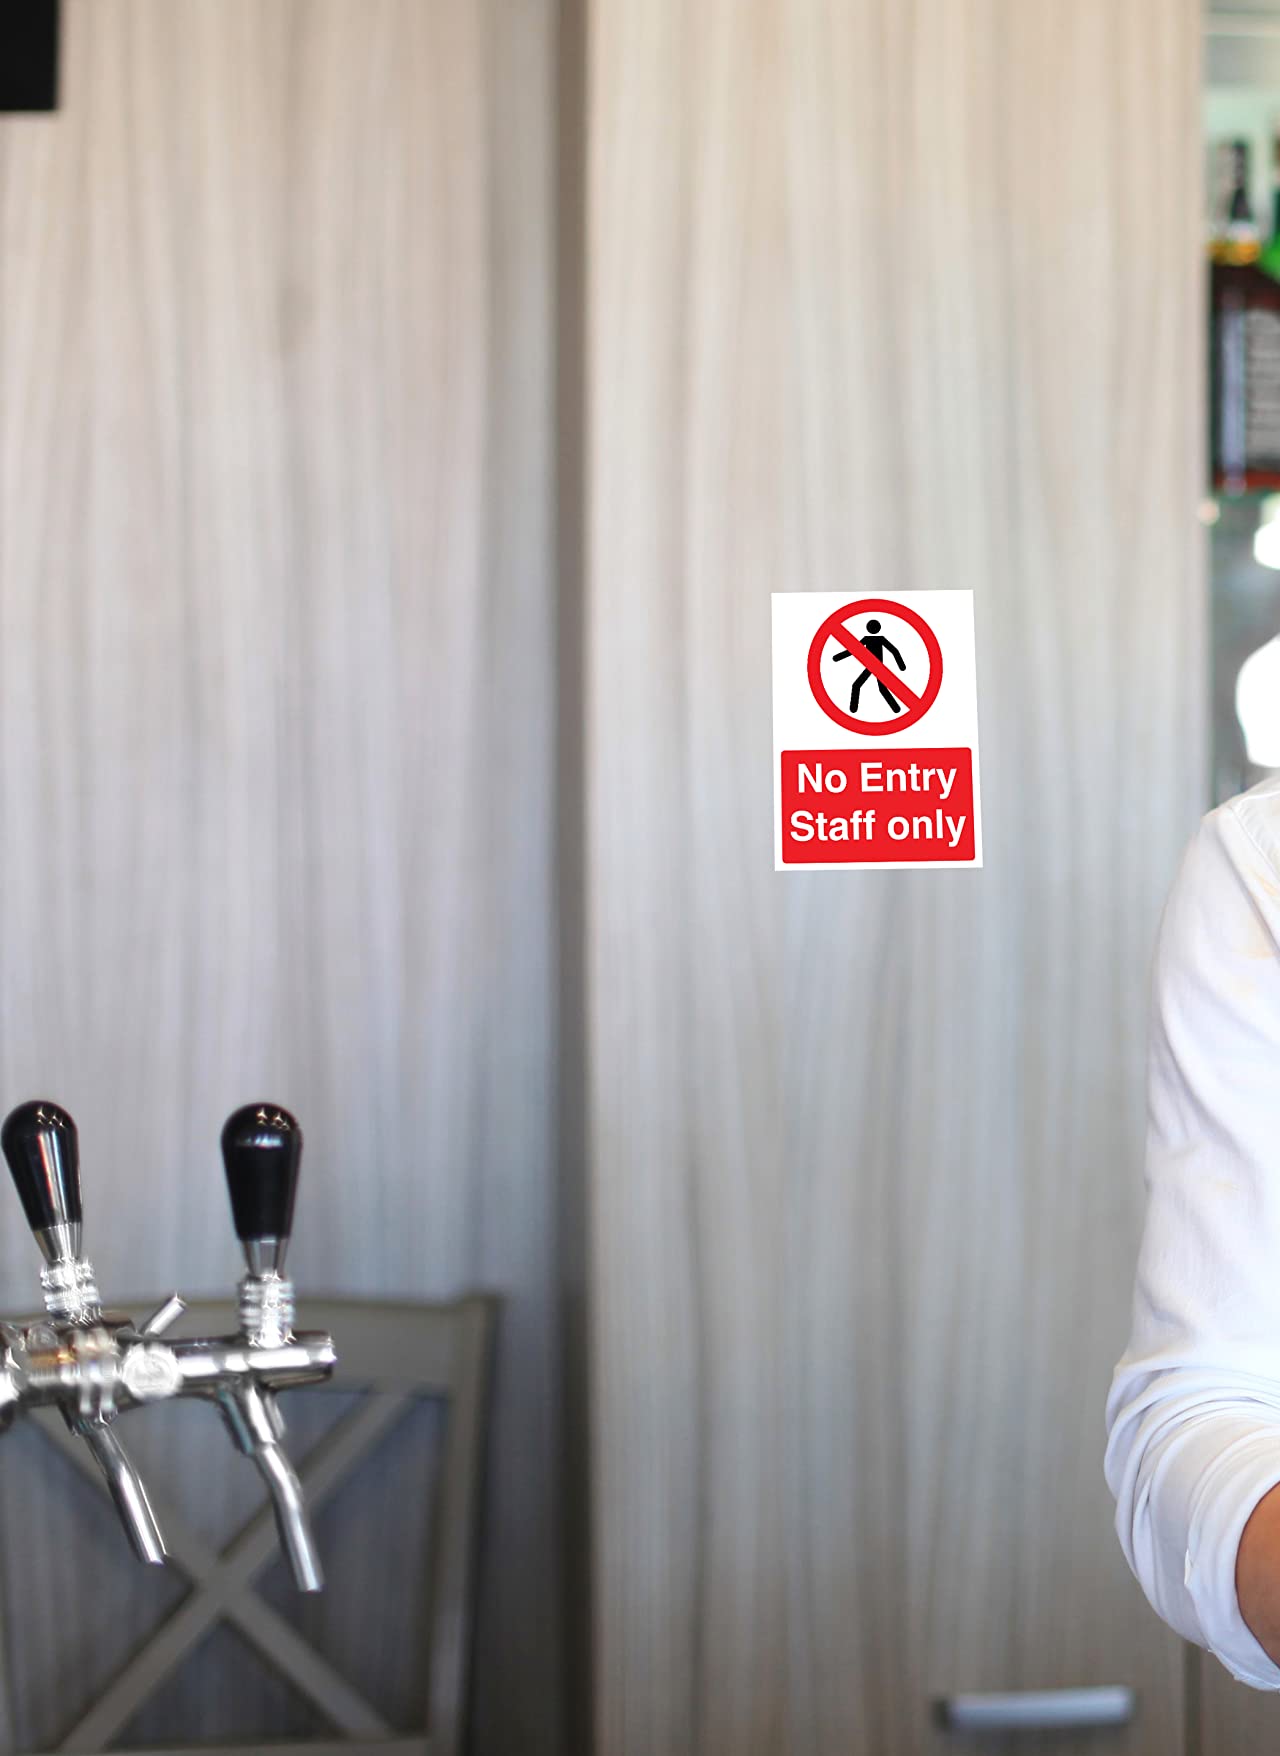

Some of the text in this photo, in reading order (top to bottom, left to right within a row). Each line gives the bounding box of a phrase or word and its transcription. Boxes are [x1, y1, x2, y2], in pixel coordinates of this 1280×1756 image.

[797, 762, 957, 799] No Entry
[790, 809, 966, 847] Staff only
